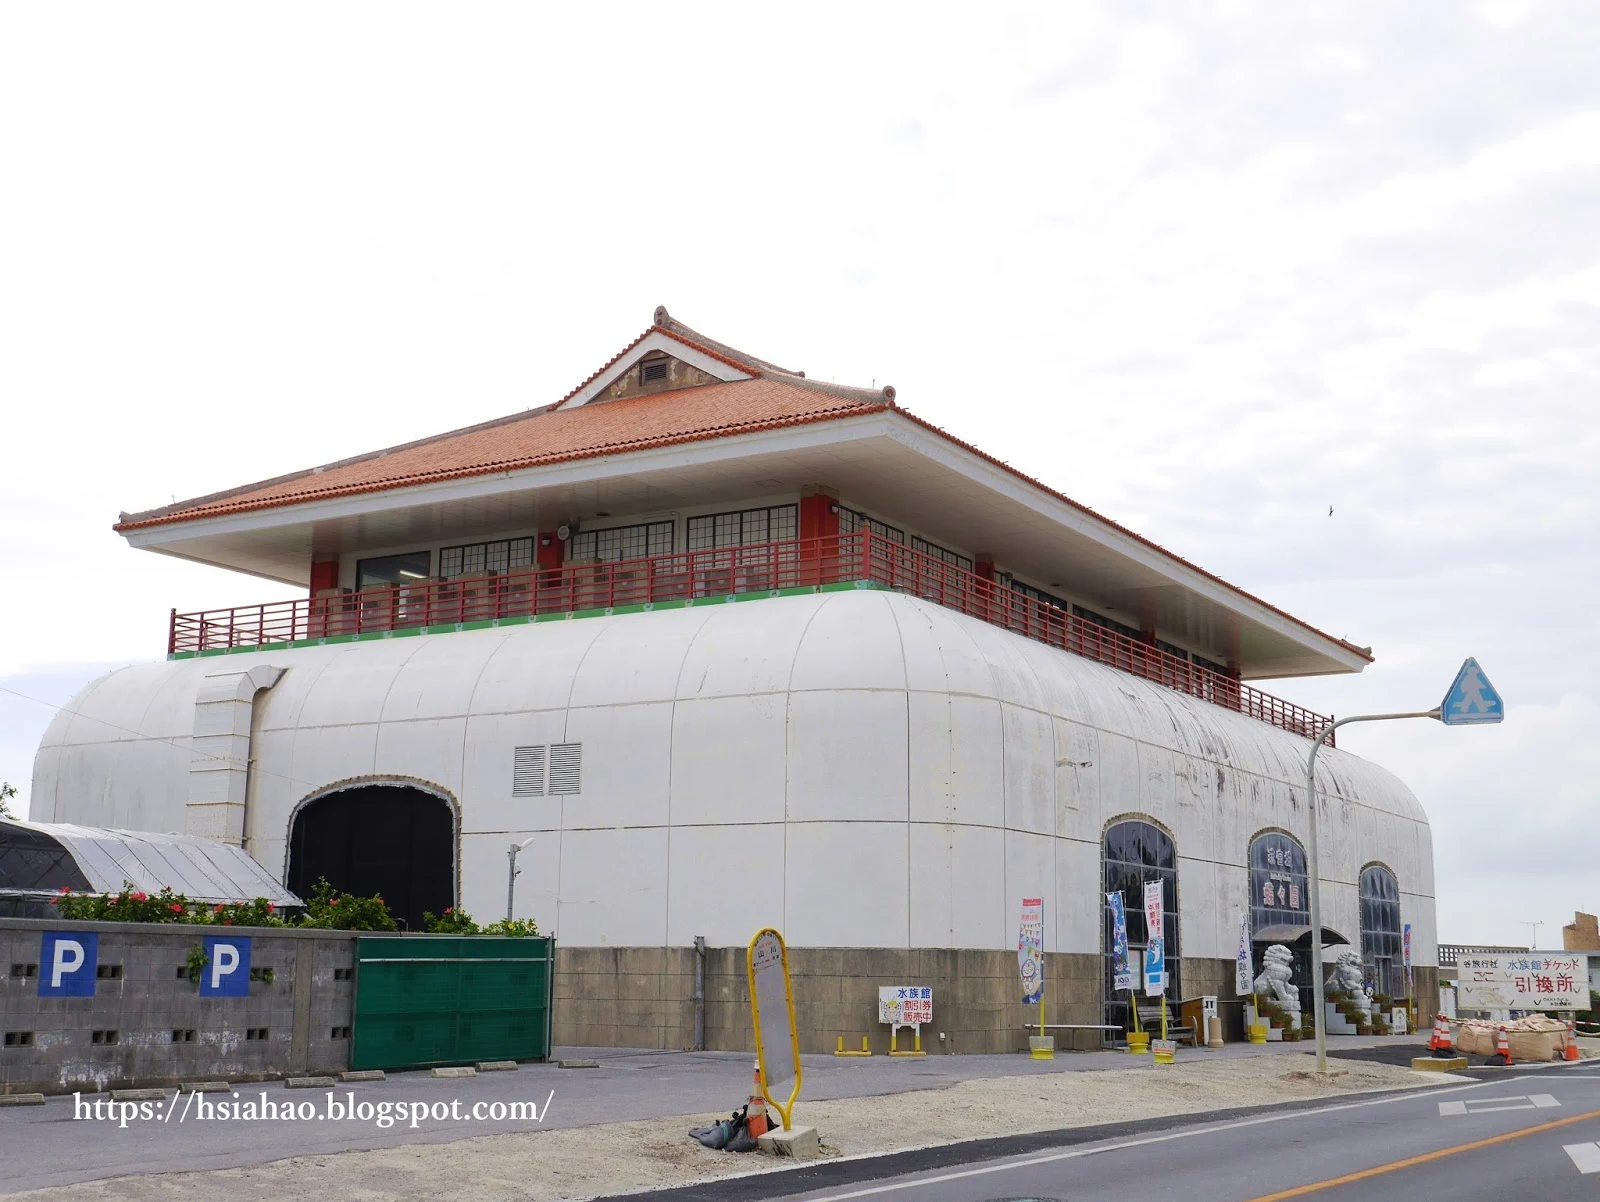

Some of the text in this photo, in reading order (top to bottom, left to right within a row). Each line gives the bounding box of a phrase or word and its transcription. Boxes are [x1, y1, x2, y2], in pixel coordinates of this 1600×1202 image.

[51, 939, 85, 988] P
[211, 943, 240, 988] P
[1507, 958, 1580, 971] 水族館チケット
[1514, 975, 1574, 993] 引換所
[897, 987, 931, 999] 水族館
[904, 999, 932, 1011] 割引券
[903, 1012, 932, 1023] 販売中
